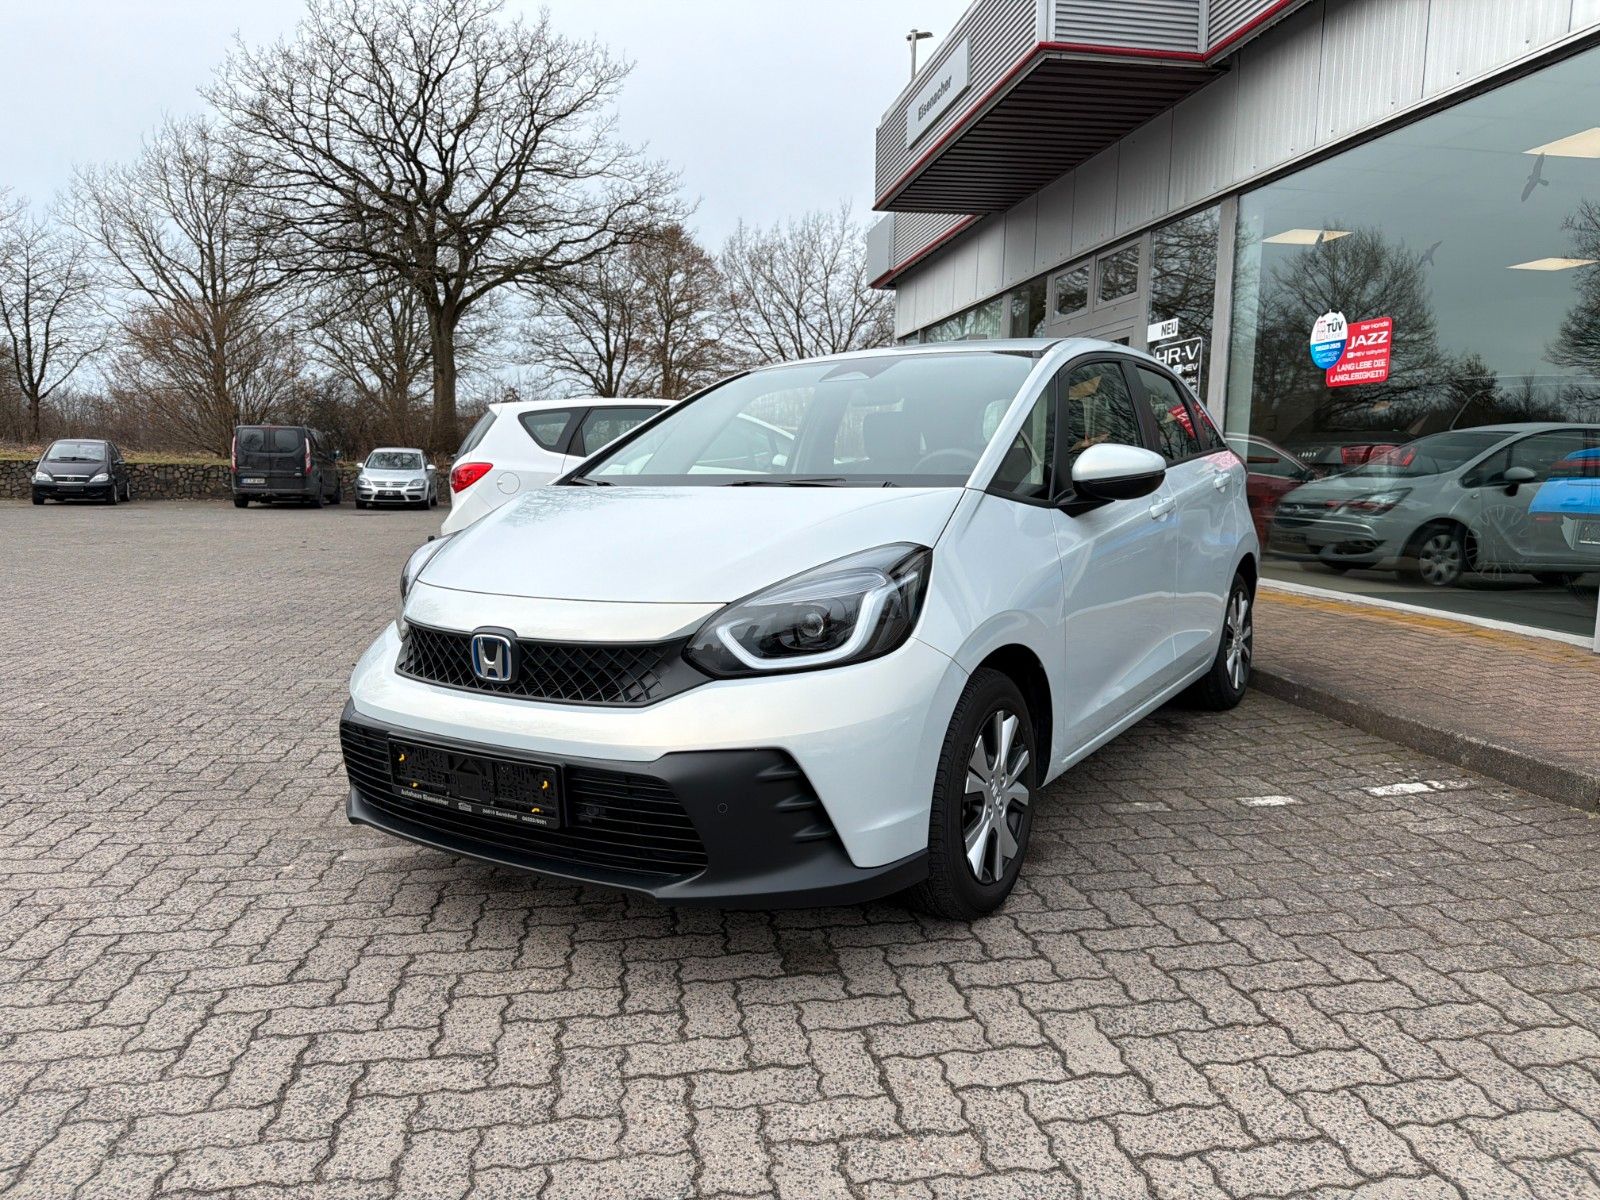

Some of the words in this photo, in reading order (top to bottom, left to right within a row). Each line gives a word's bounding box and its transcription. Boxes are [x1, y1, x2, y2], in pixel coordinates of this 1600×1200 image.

[918, 75, 952, 121] Eisenacher
[1161, 321, 1176, 336] NEU
[1327, 318, 1344, 333] TÜV
[1347, 330, 1389, 350] JAZZ
[1156, 343, 1200, 365] HR-V
[1337, 364, 1355, 372] LANG
[1355, 359, 1373, 370] LEBE
[1374, 358, 1387, 367] DIE
